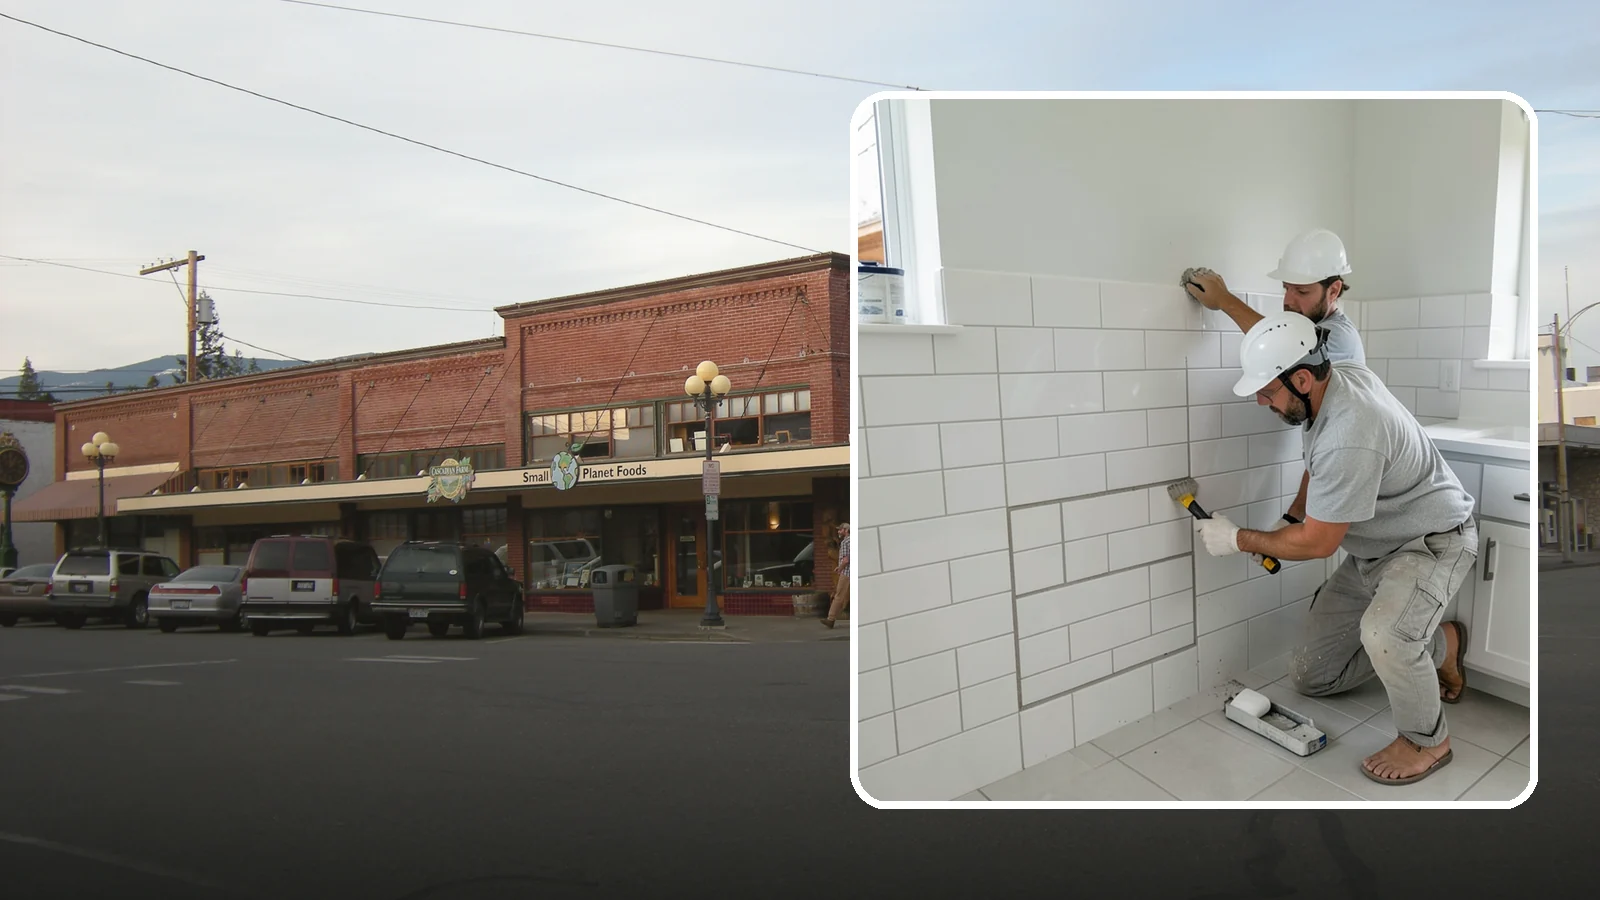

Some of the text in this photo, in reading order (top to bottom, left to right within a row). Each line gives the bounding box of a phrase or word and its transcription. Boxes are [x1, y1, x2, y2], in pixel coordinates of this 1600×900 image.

[523, 464, 647, 483] Small Planet Foods
